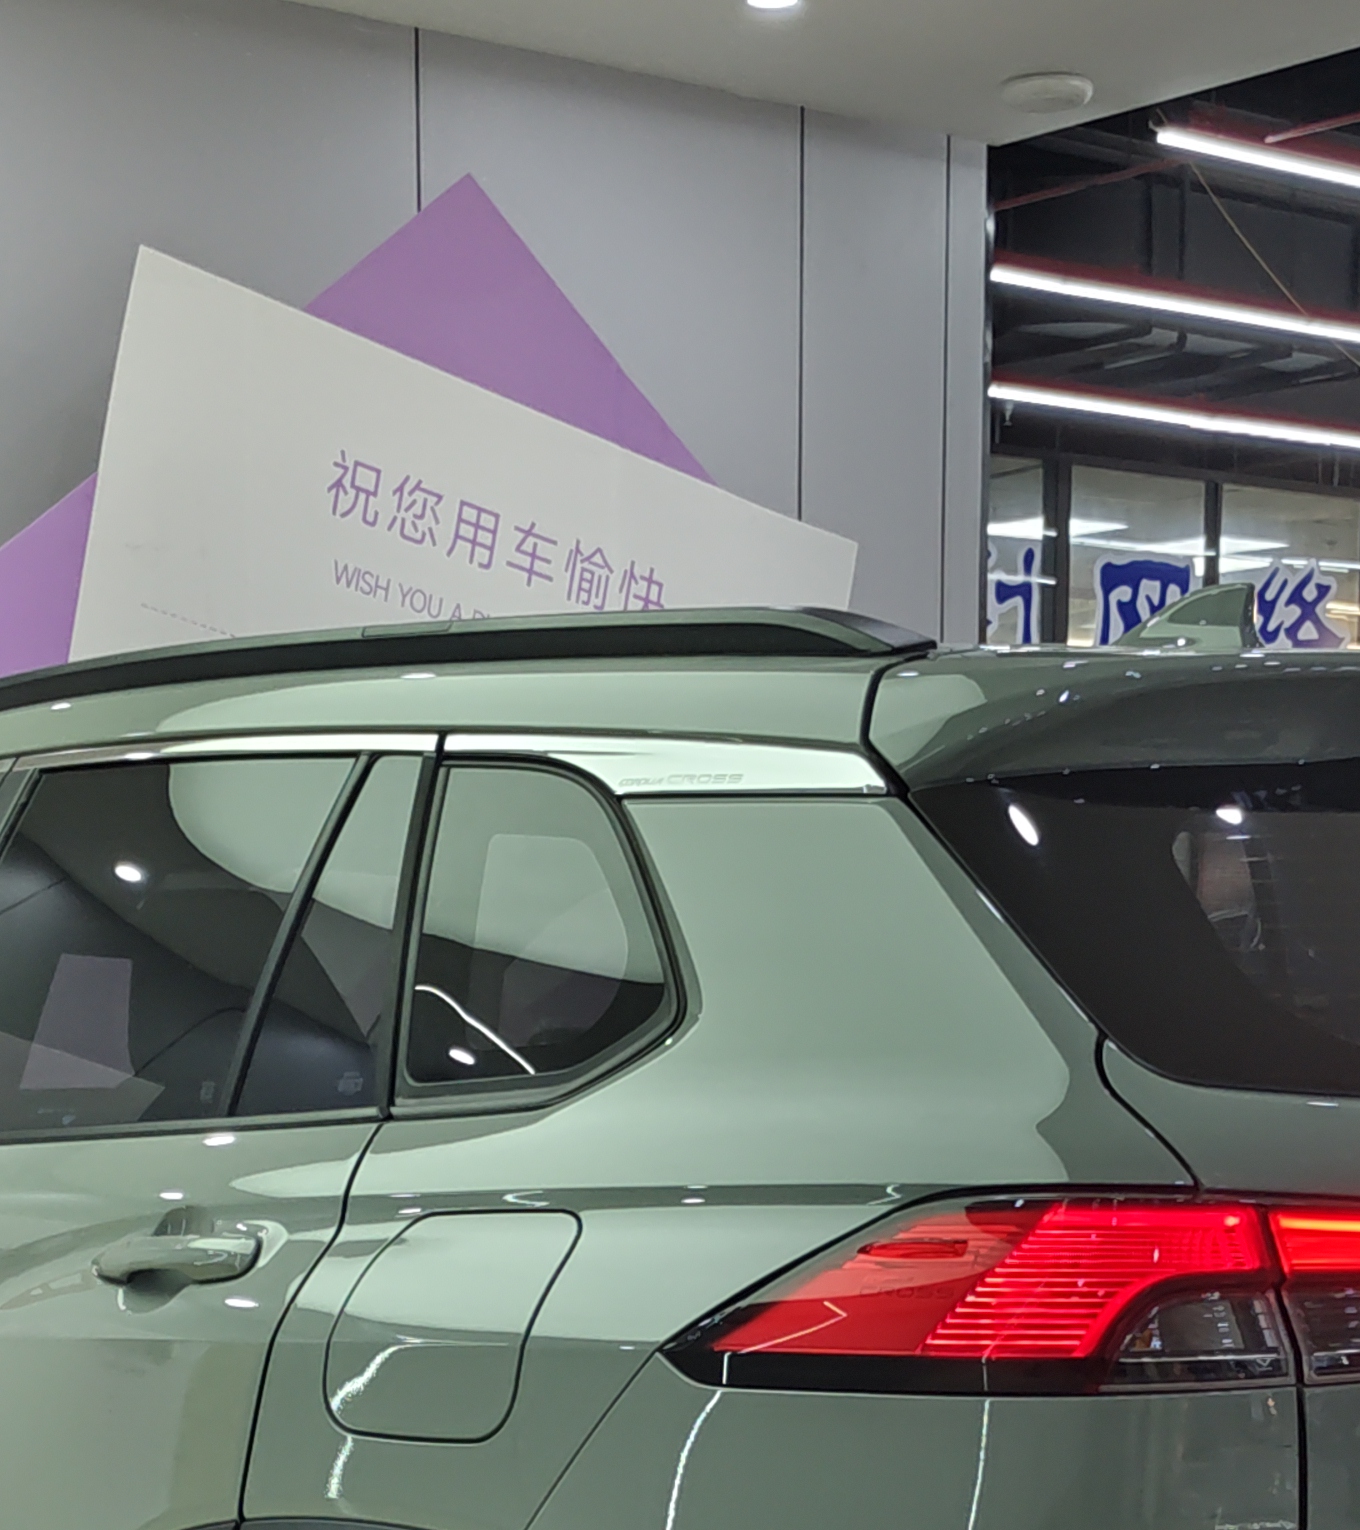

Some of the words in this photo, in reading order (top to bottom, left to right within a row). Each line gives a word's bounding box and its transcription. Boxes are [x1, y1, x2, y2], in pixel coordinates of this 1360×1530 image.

[326, 448, 666, 611] 祝您用车愉快
[333, 558, 391, 603] WISH
[398, 581, 445, 619] YOU
